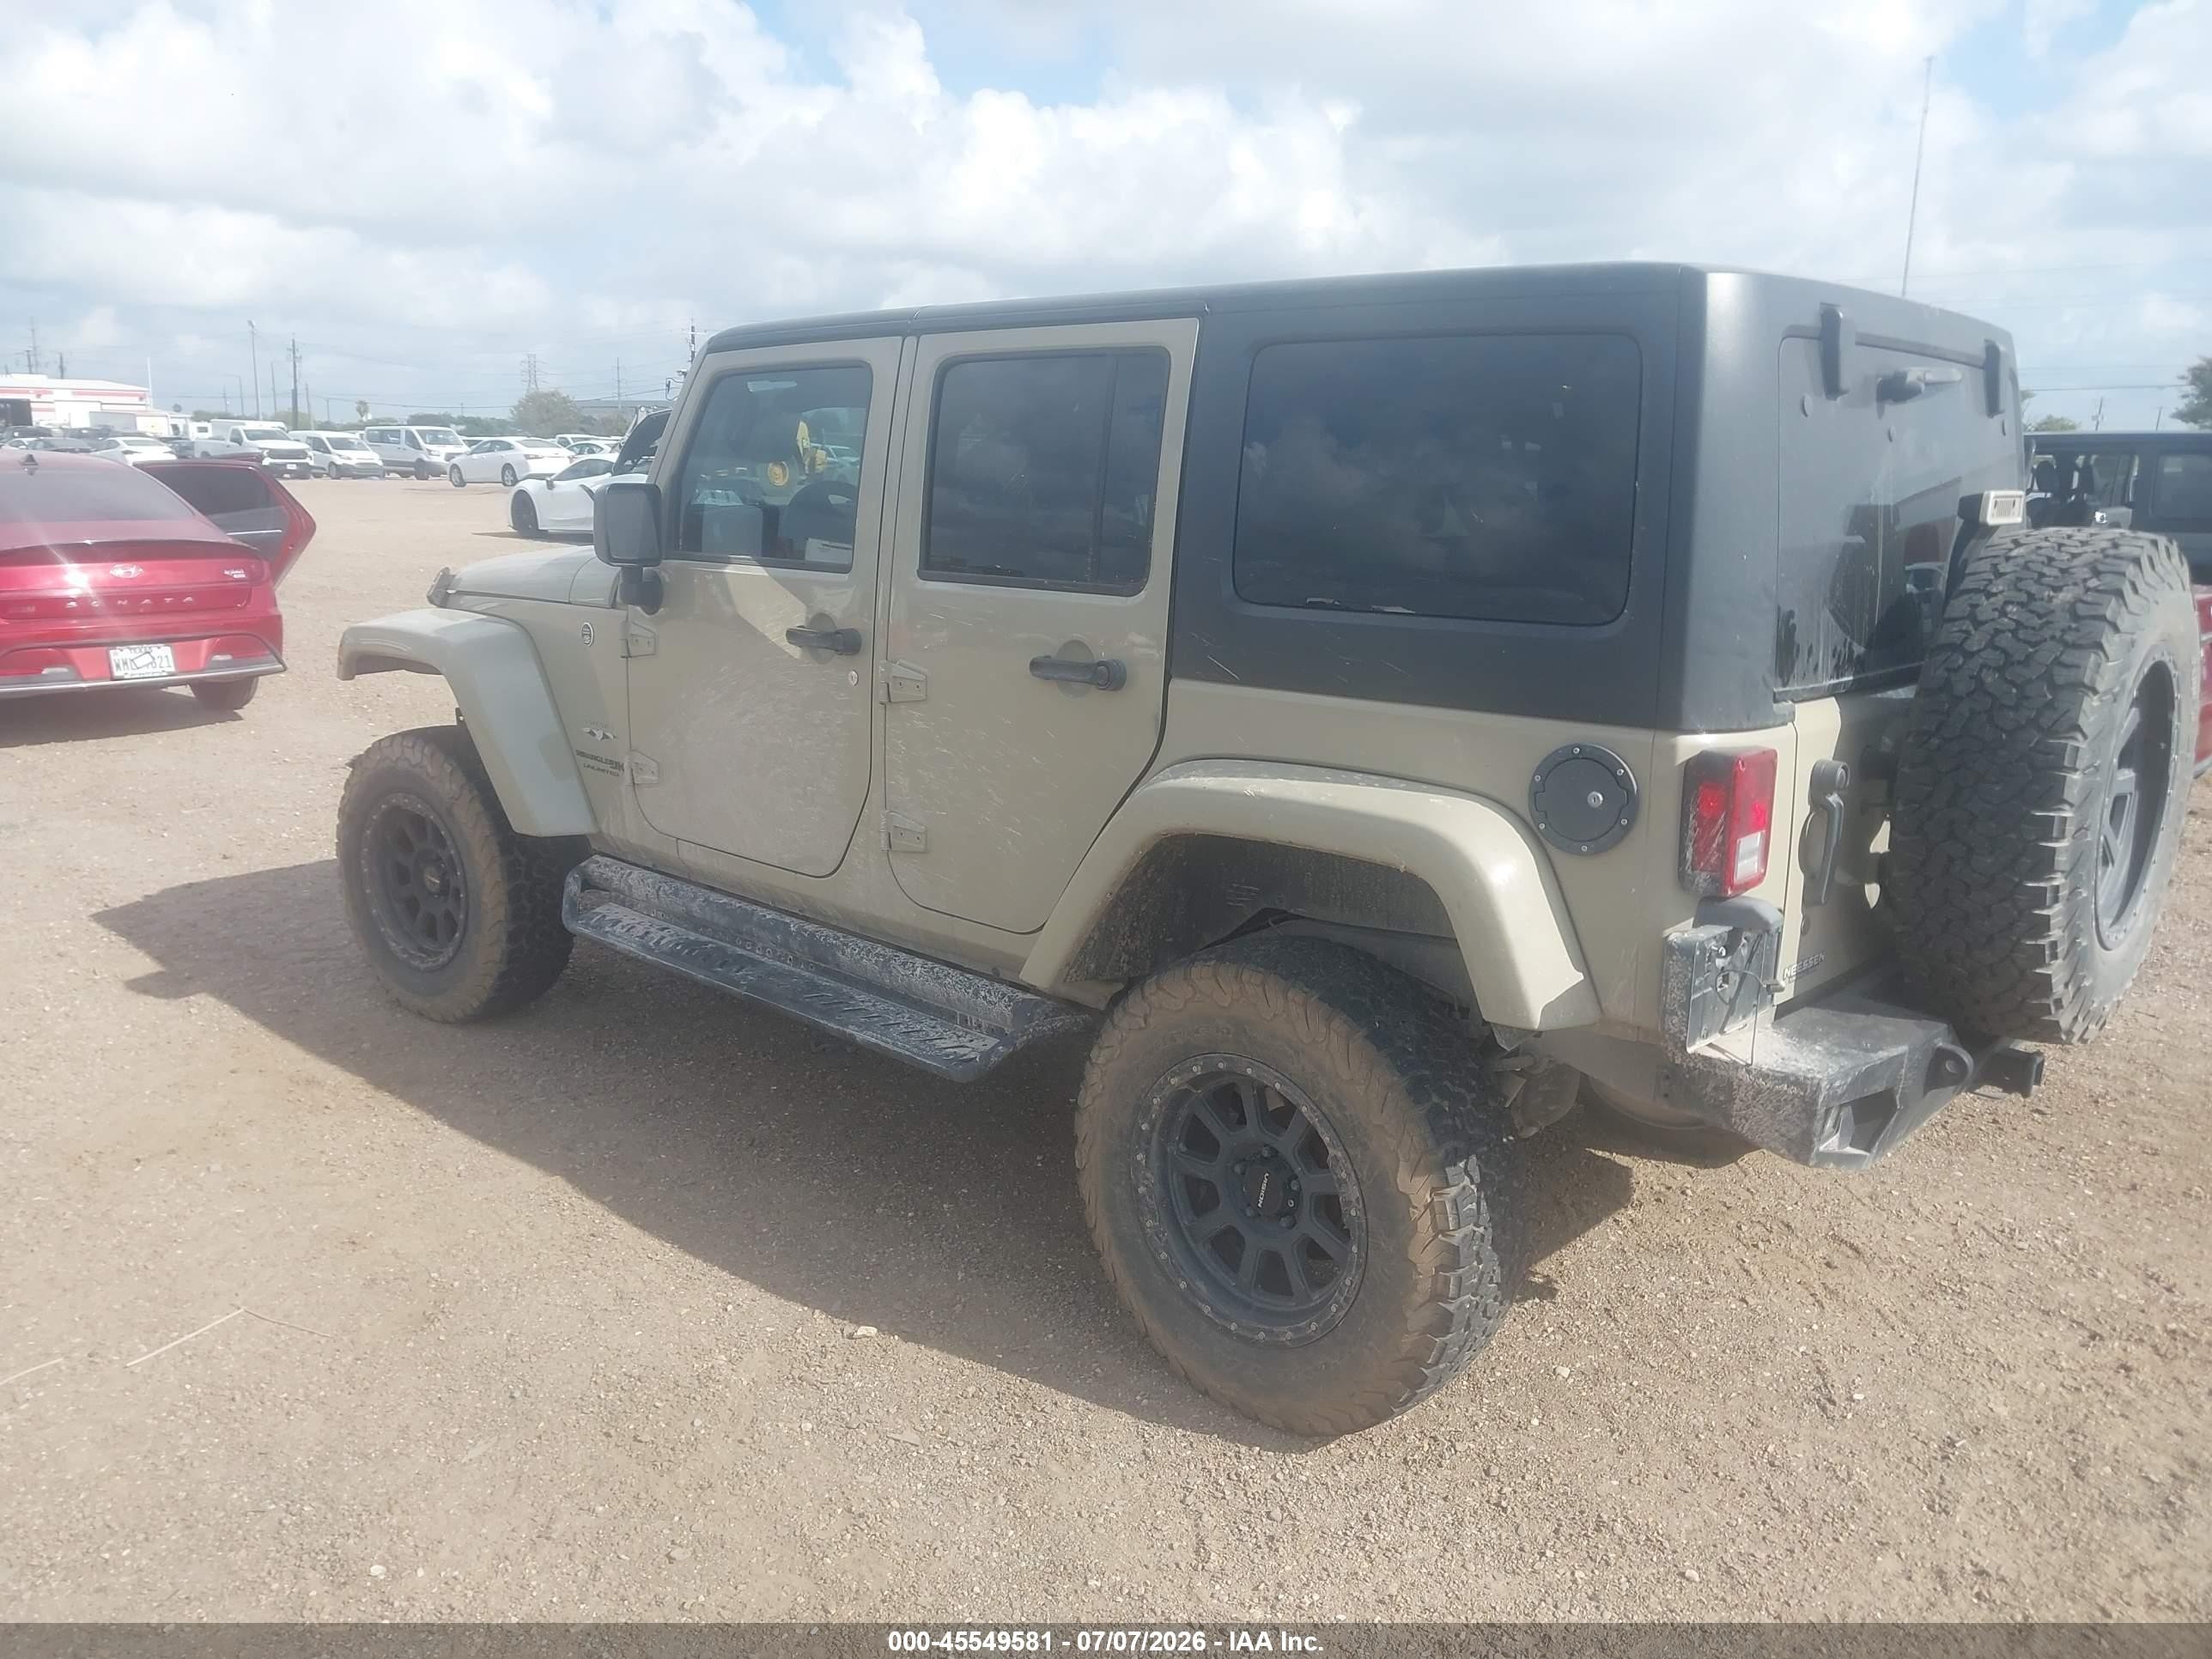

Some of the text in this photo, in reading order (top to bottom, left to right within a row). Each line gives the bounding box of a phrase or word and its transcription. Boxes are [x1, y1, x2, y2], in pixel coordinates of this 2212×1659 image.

[65, 595, 194, 609] SONATA
[1783, 952, 1825, 980] NEESSEN
[1257, 1172, 1270, 1208] VISION
